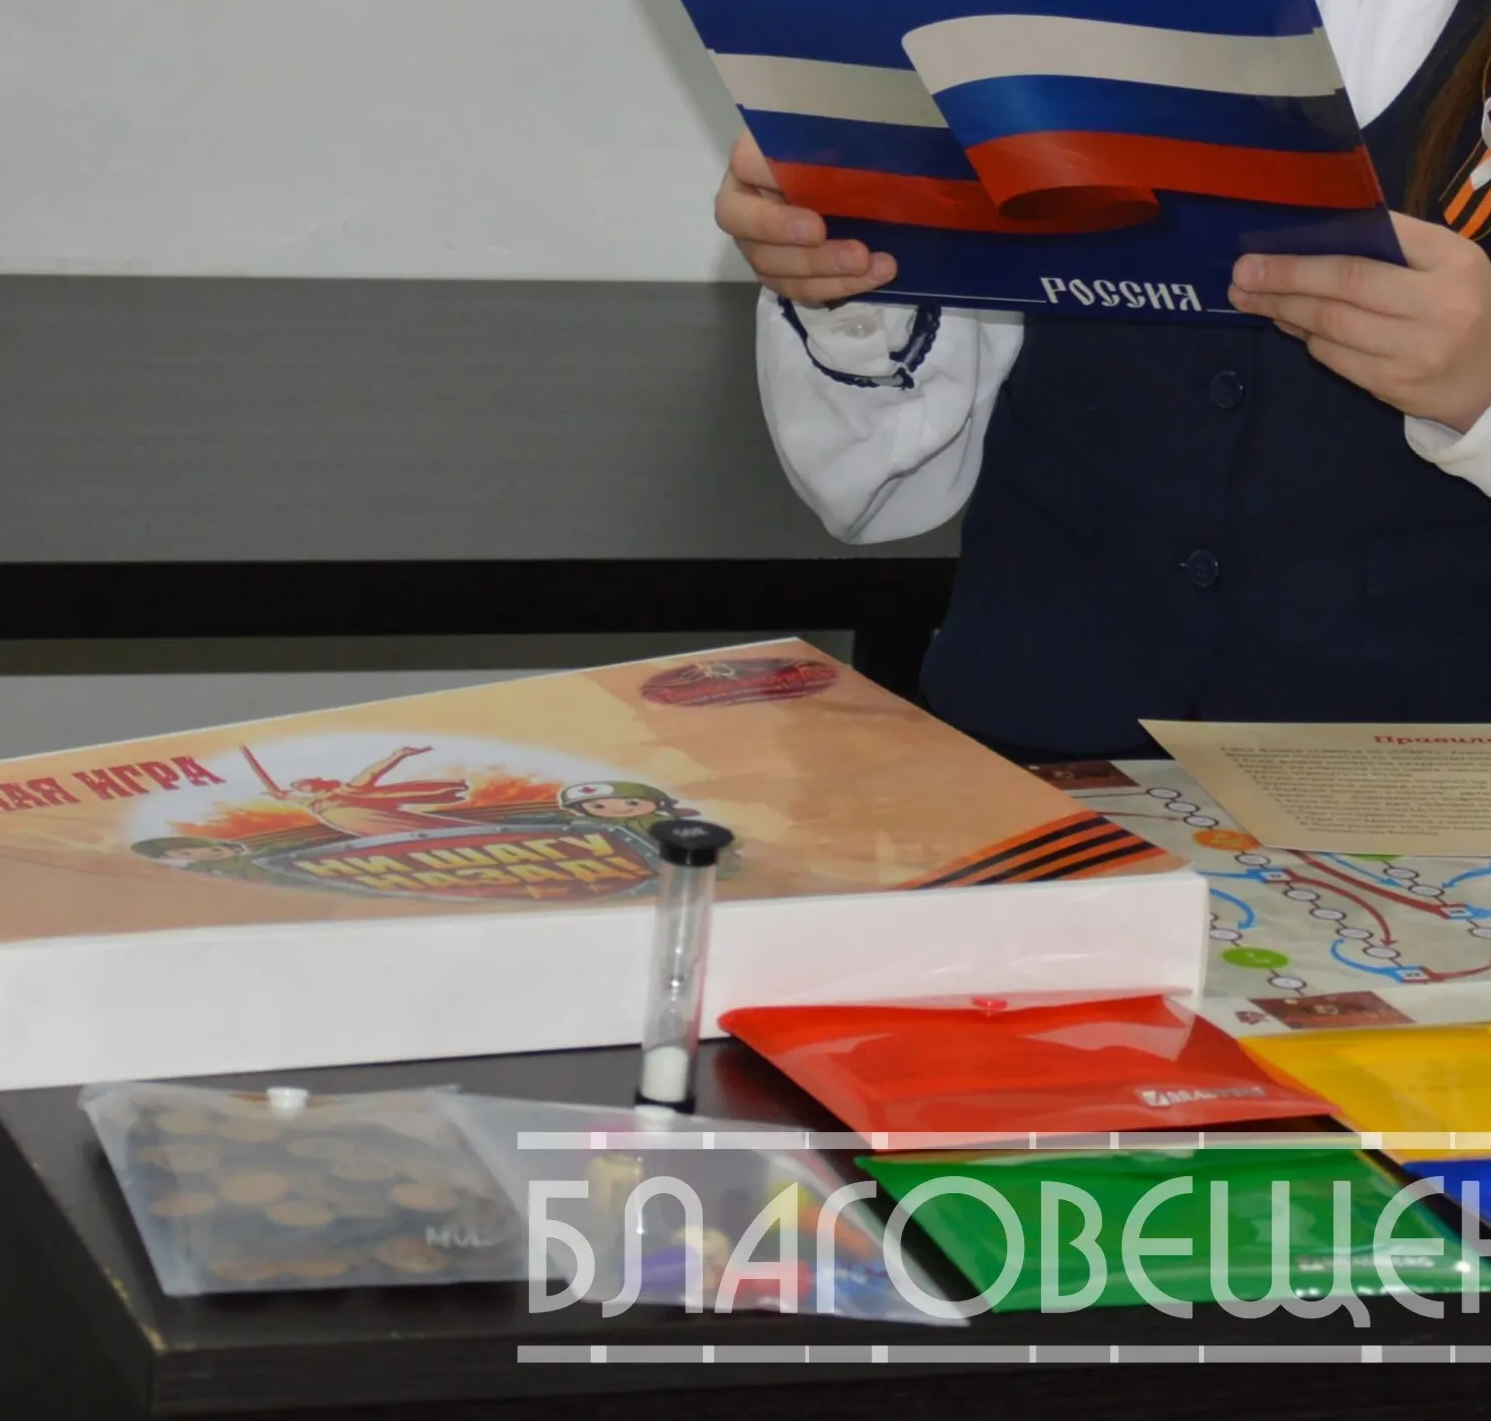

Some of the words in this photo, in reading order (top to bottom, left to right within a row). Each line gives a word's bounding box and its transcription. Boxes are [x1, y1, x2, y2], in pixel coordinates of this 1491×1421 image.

[1040, 277, 1203, 312] РОССИЯ
[72, 754, 227, 801] ИГРА
[292, 854, 414, 877] НИ
[408, 833, 615, 870] ШАГУ
